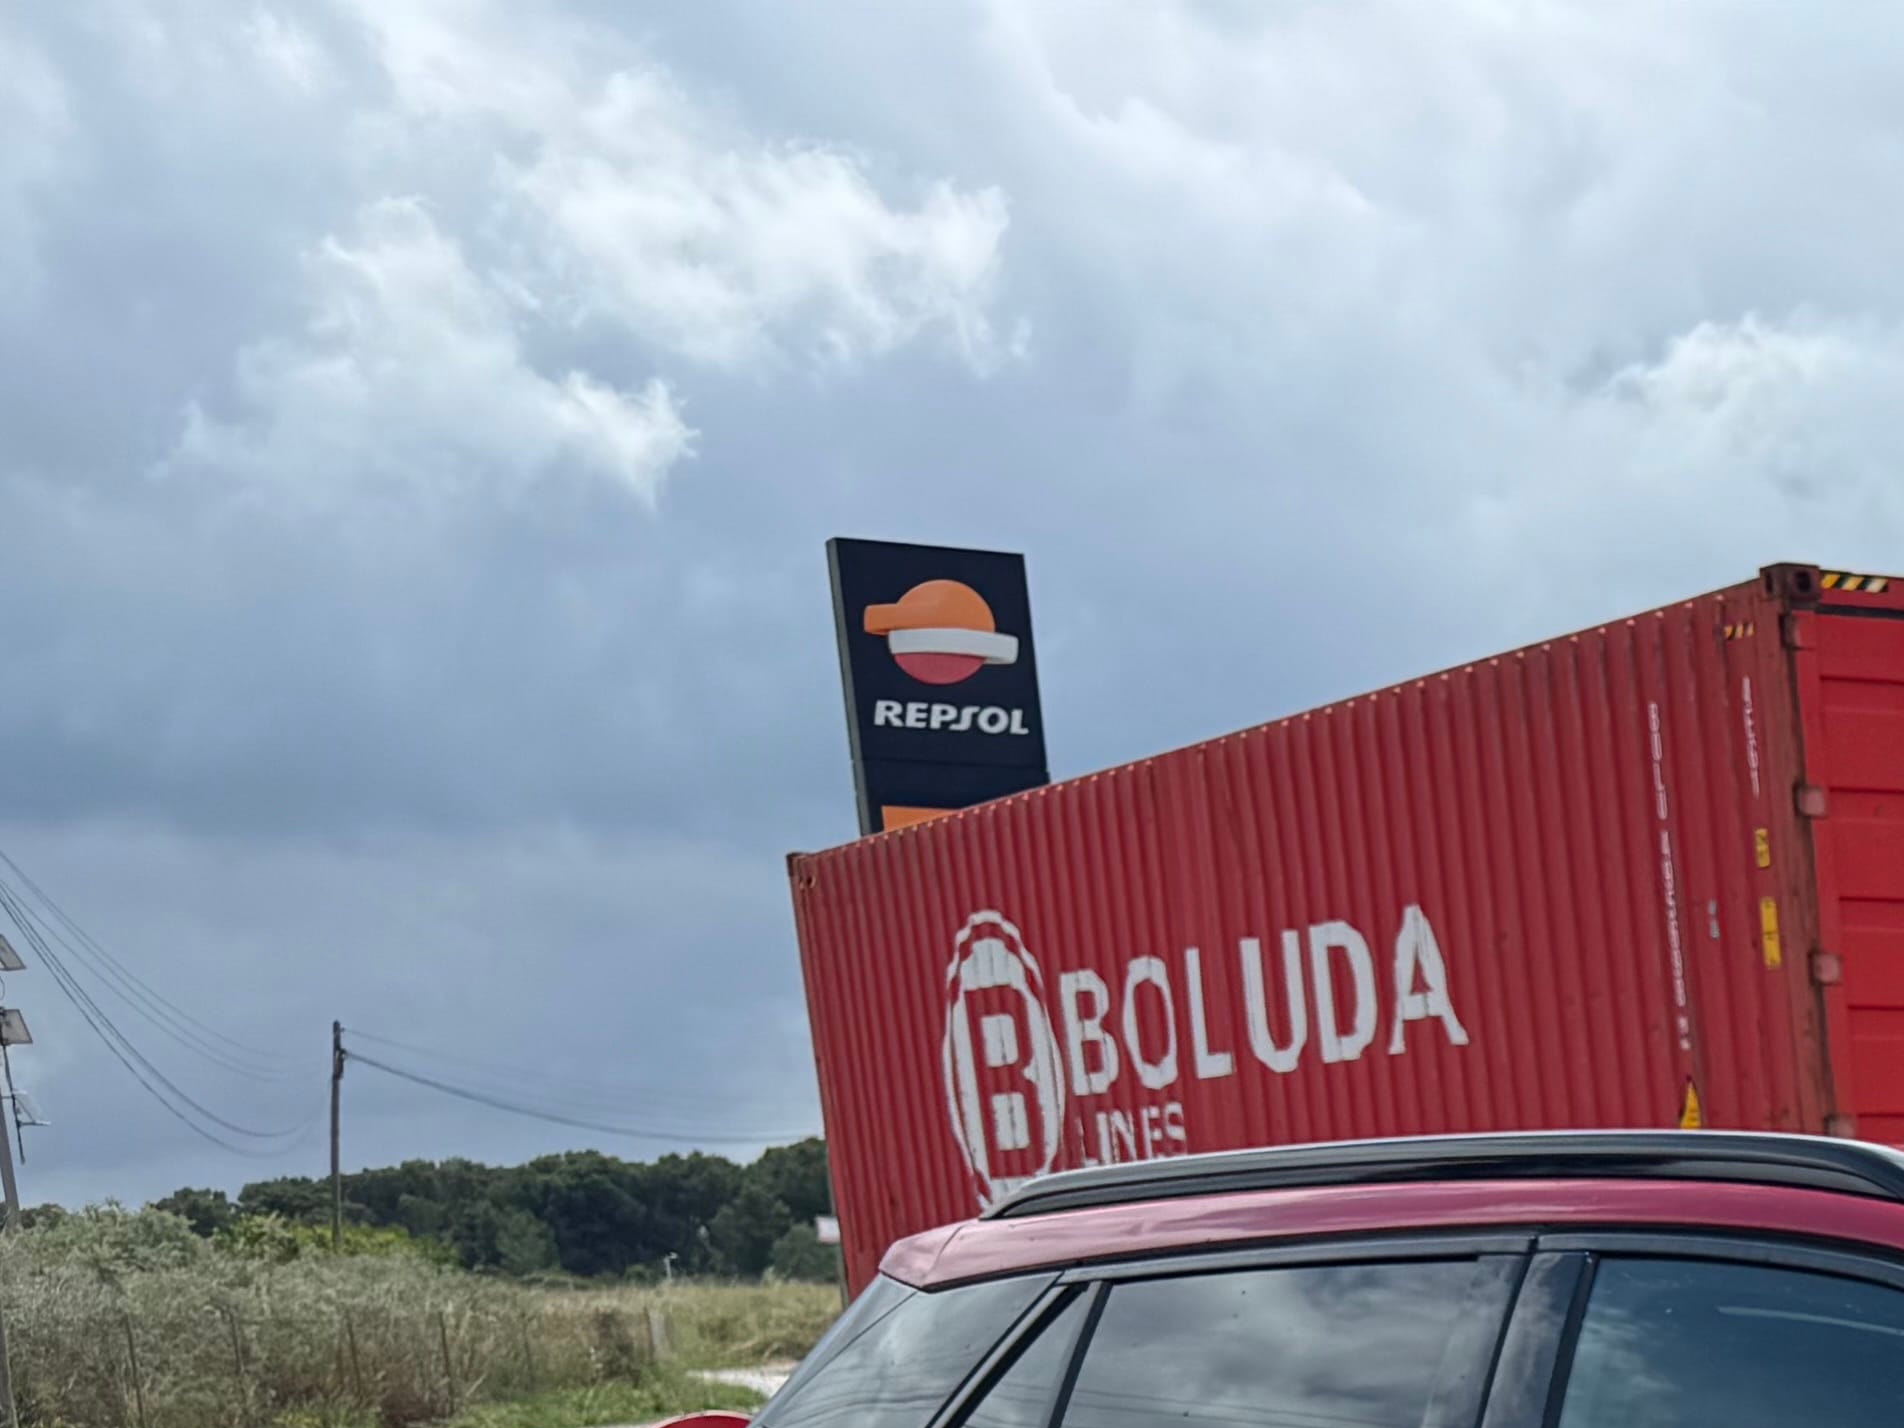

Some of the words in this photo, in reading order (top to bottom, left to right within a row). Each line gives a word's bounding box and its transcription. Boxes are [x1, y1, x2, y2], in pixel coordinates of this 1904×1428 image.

[874, 699, 1029, 735] REPSOL
[1060, 904, 1469, 1096] BOLUDA
[1078, 1101, 1187, 1166] LINES
